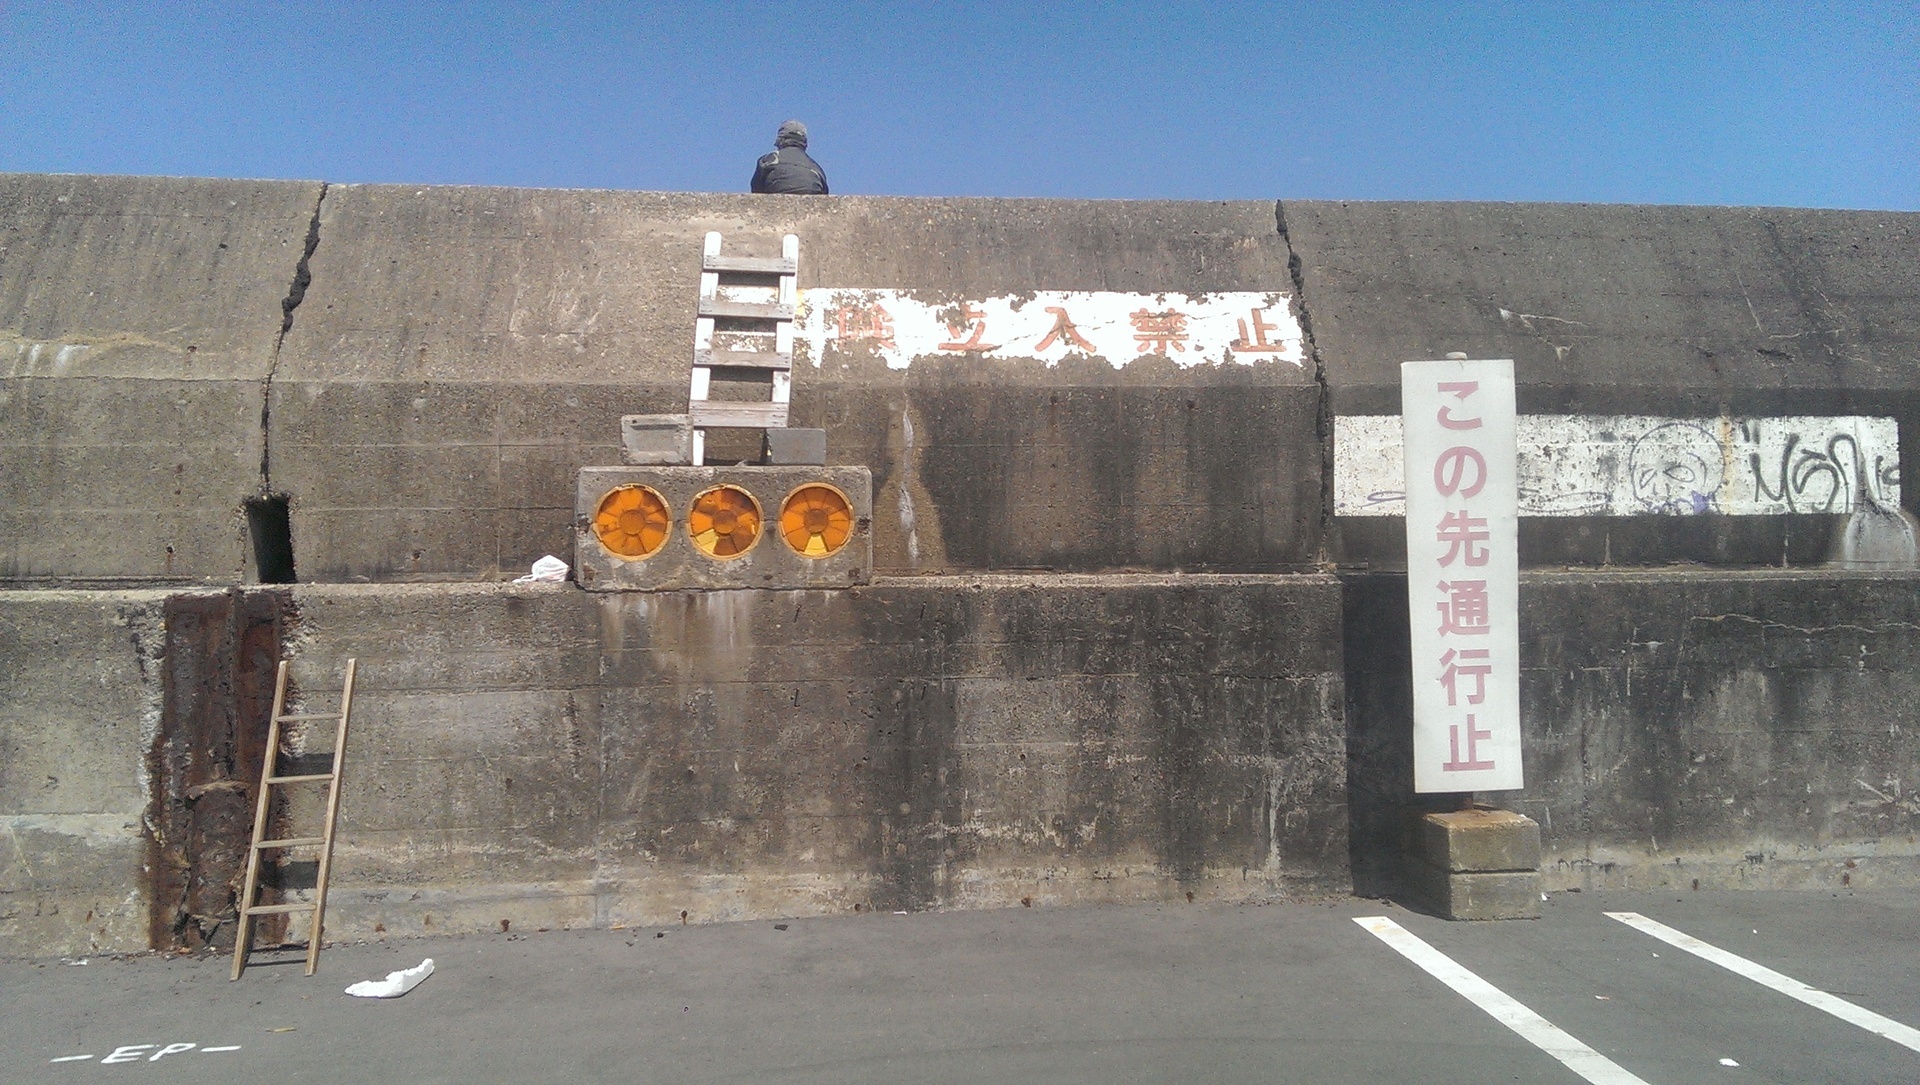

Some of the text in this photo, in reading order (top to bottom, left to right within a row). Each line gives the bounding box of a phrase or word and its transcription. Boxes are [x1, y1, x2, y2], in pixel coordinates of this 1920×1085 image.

[1433, 381, 1496, 772] この先通行止
